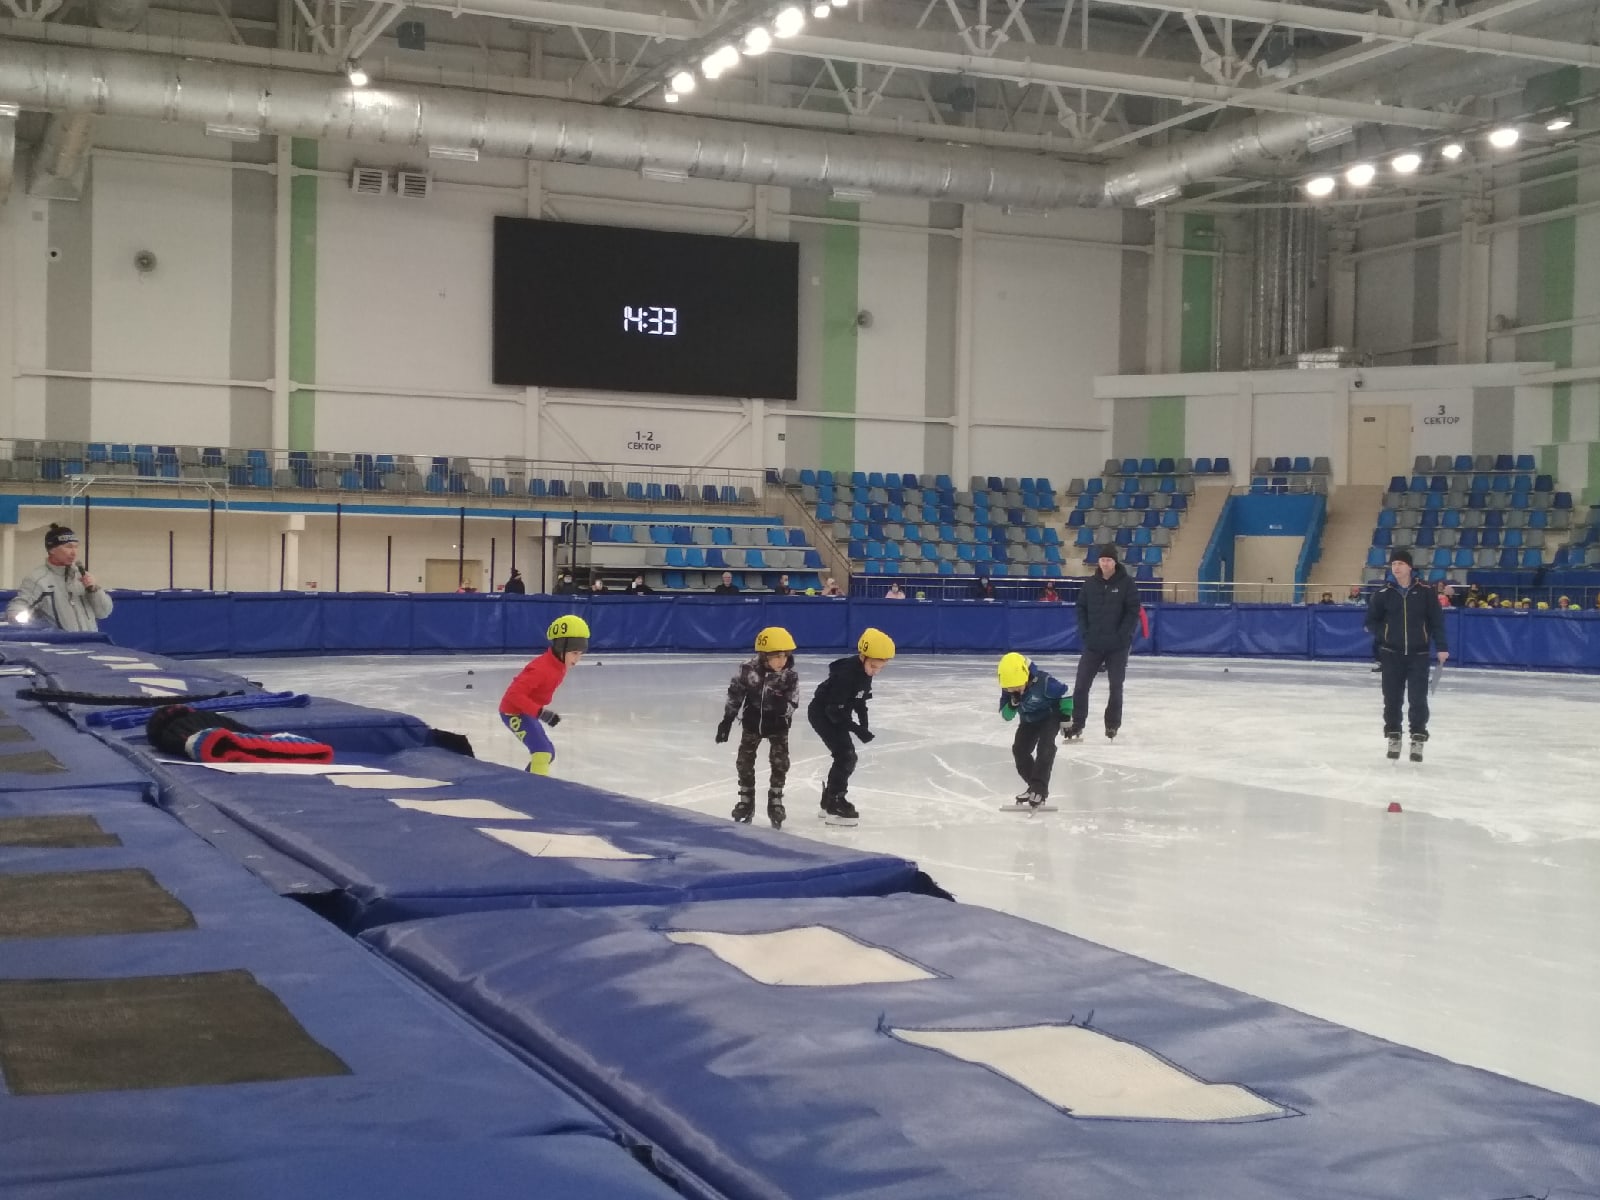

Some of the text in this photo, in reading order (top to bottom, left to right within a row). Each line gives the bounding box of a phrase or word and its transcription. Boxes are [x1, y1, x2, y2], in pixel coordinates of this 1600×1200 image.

[623, 305, 677, 336] 14:33
[1437, 404, 1446, 416] 3
[1423, 416, 1460, 425] СЕКТОР
[635, 430, 654, 441] 1-2
[627, 441, 662, 451] СЕКТОР
